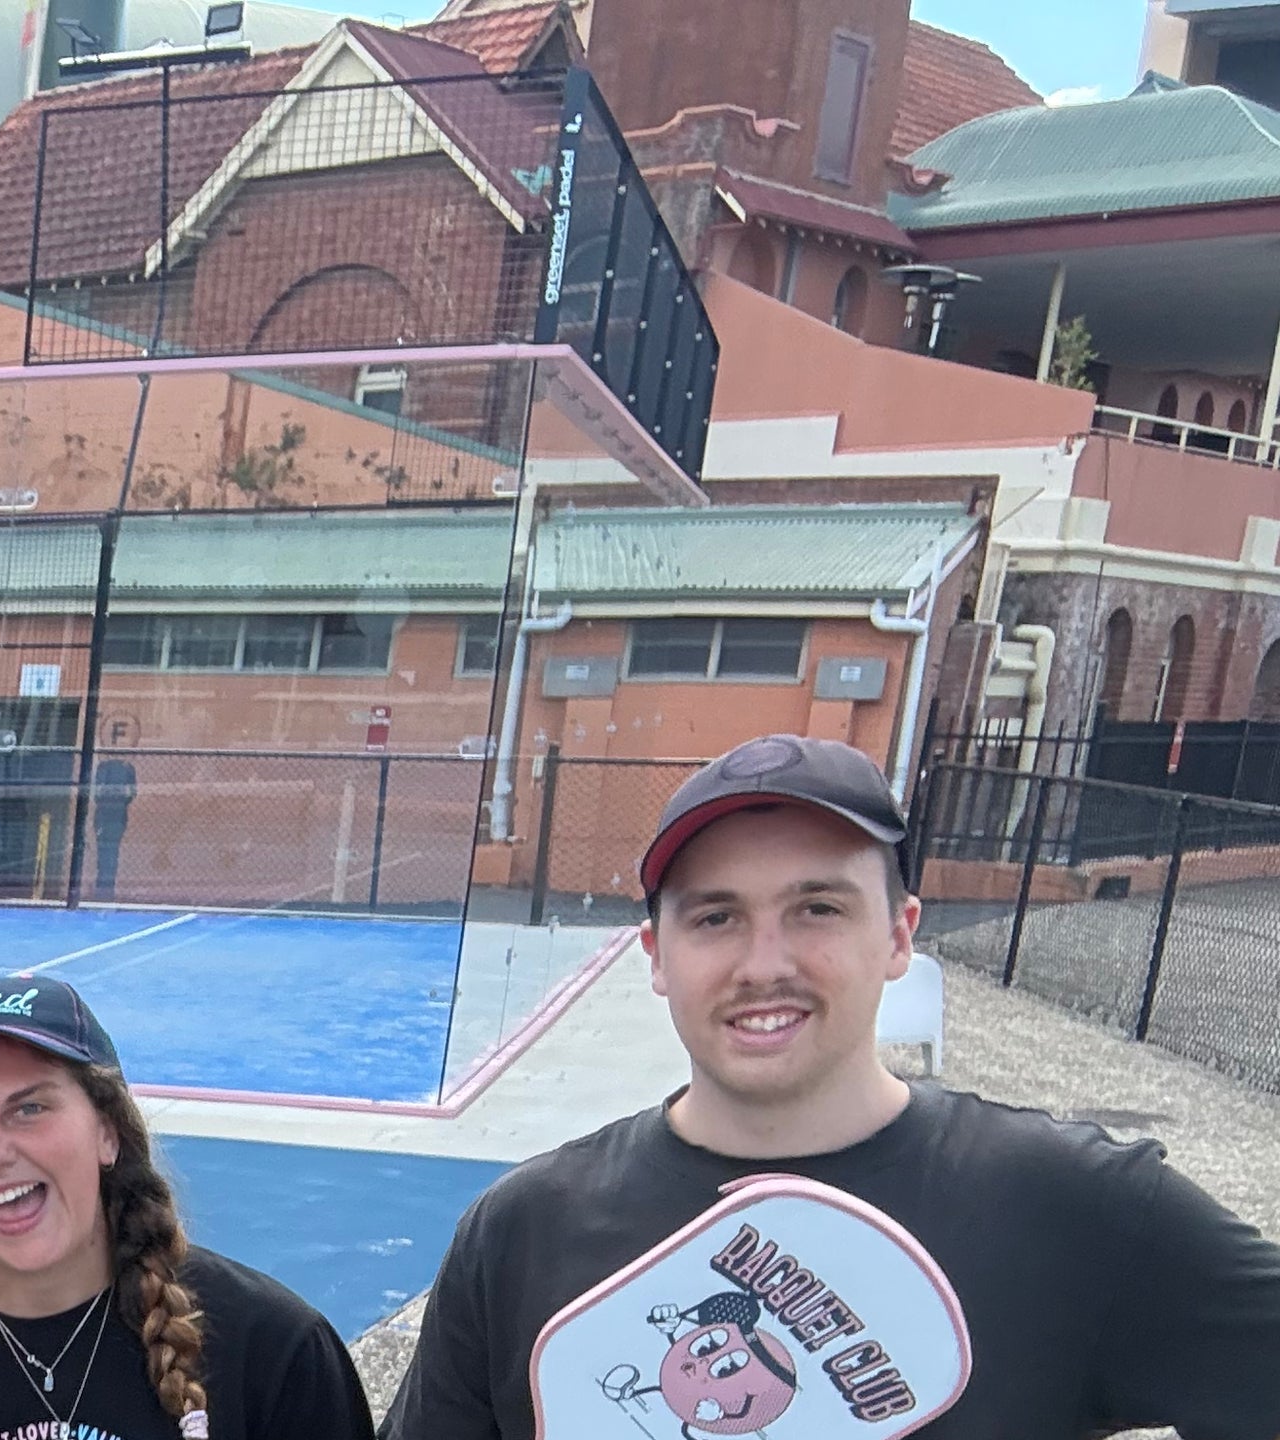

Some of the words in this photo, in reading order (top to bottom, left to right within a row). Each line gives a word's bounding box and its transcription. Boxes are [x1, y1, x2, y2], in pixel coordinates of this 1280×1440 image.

[545, 211, 569, 304] greenset
[559, 149, 576, 207] padel
[710, 1223, 866, 1353] RACQUET
[822, 1339, 916, 1422] CLUB
